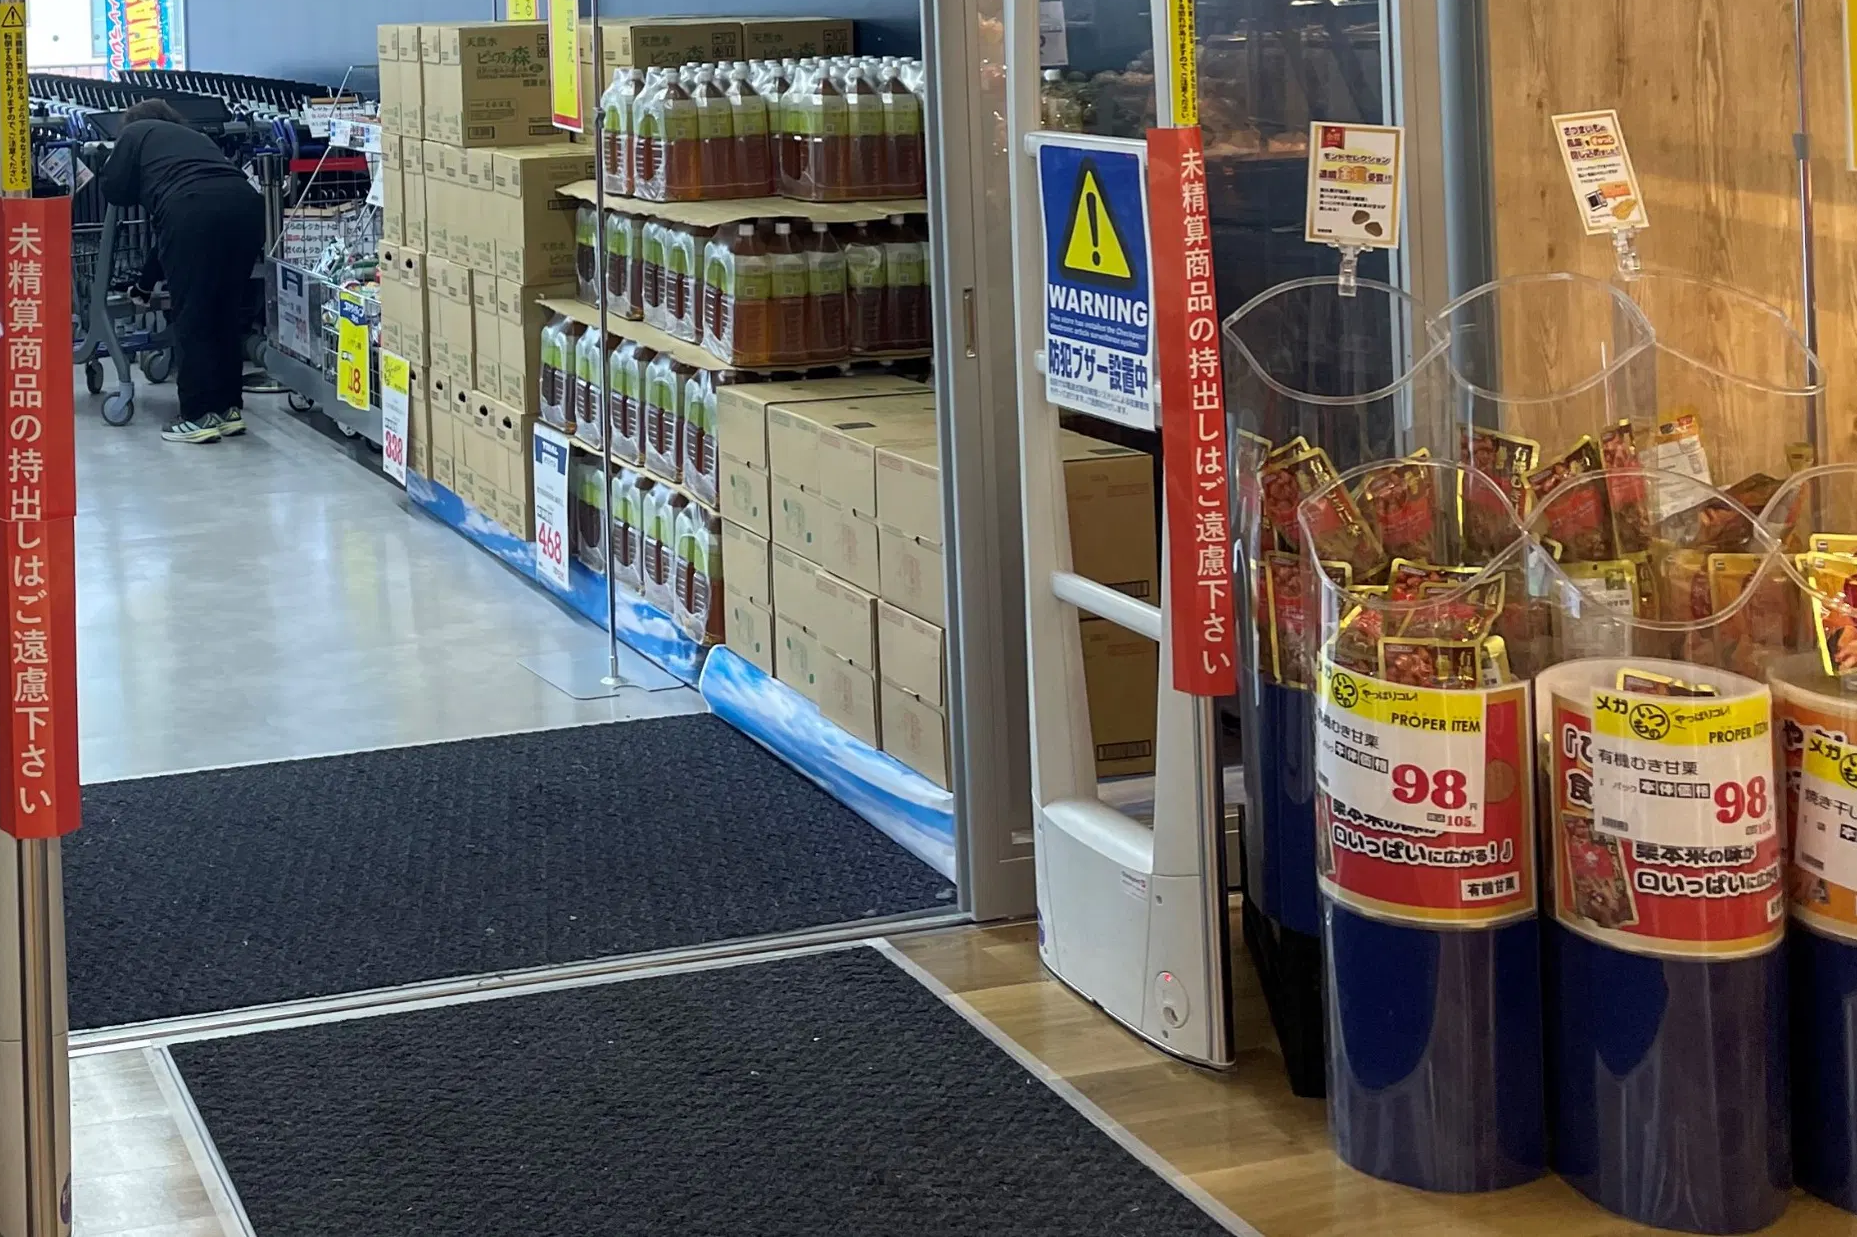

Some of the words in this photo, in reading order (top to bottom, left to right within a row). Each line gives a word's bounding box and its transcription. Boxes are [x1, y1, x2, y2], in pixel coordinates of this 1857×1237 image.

[1048, 284, 1148, 327] WARNING
[1048, 338, 1148, 399] 防犯ブザー設置中
[1181, 148, 1231, 674] 未精算商品の持出しはご遠慮下さい
[9, 222, 51, 814] 未精算商品の持出しはご遠慮下さい
[538, 522, 562, 565] 468
[1391, 712, 1447, 731] PROPER
[1451, 719, 1481, 733] ITEM
[1596, 696, 1629, 714] メガ
[1709, 726, 1752, 744] PROPER
[1809, 738, 1842, 761] メガ
[1597, 748, 1698, 776] 有機むき甘栗
[1391, 764, 1467, 810] 98
[1713, 775, 1767, 825] 98
[1446, 816, 1472, 828] 105
[1467, 876, 1516, 898] 有機甘栗
